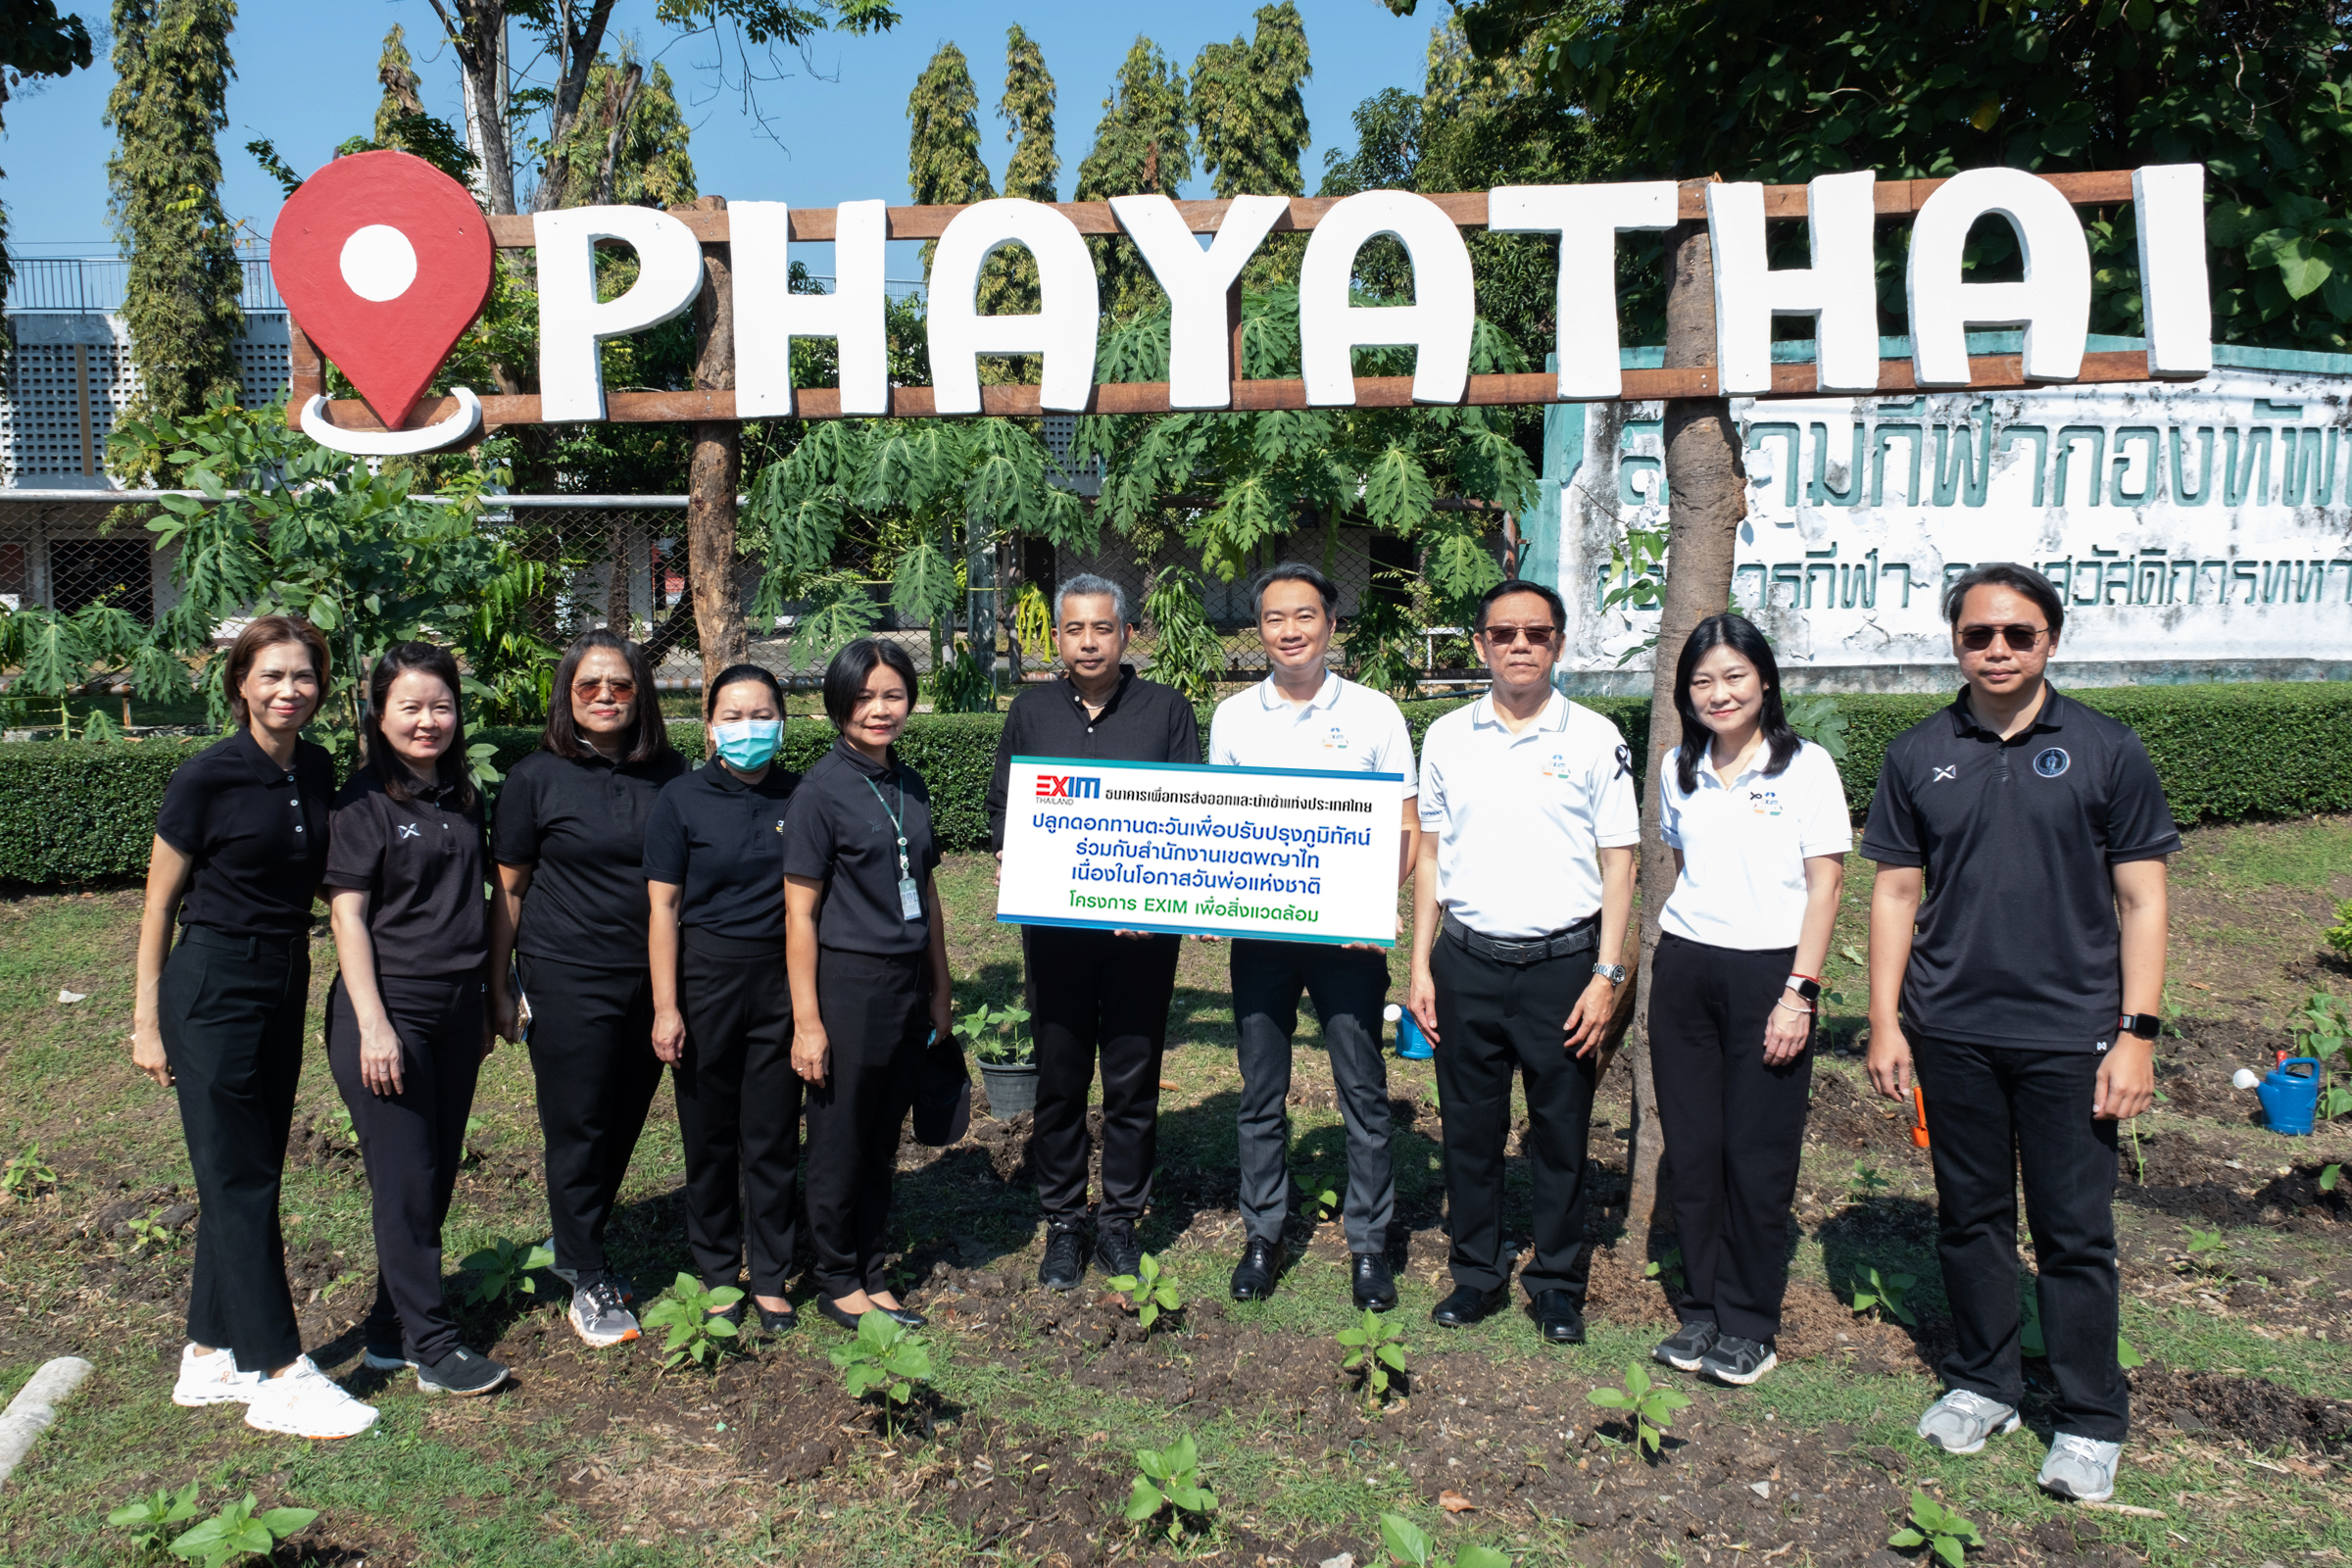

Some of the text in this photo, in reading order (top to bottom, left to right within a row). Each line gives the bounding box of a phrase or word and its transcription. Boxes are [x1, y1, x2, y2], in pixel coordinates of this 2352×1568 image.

[533, 163, 2212, 421] PHAYATHAI
[1035, 797, 1075, 806] THAILAND
[1105, 787, 1372, 812] ธนาคารเพื่อการส่งออกและนำเข้าแห่งประเทศไทย
[1033, 813, 1371, 848] ปลูกดอกทานตะวันเพื่อปรับปรุงภูมิทัศน์
[1076, 837, 1320, 868] ร่วมกับสำนักงานเขตพญาไท
[1072, 858, 1321, 894] เนื่องในโอกาสวันพ่อแห่งชาติ
[1069, 890, 1319, 922] โครงการ EXIM เพื่อสิ่งแวดล้อม
